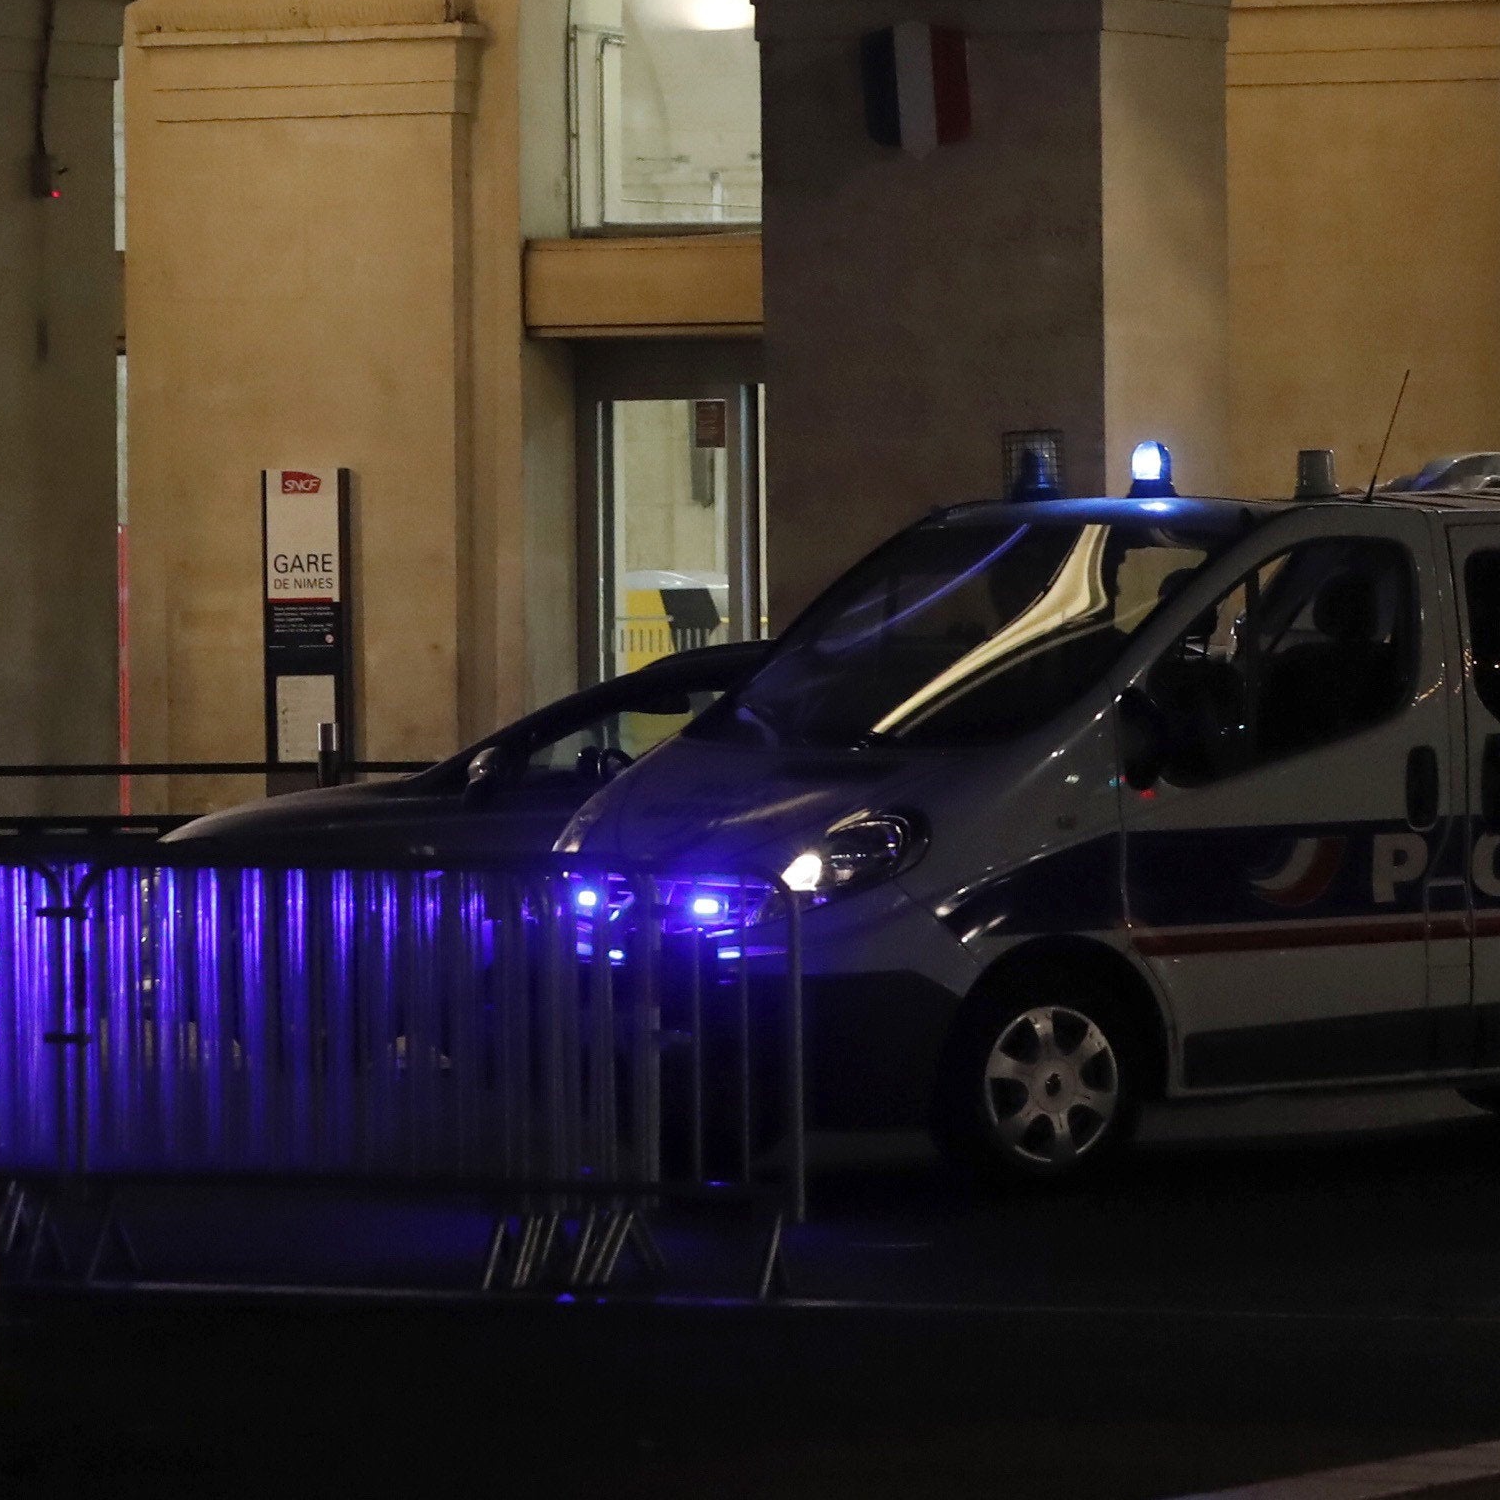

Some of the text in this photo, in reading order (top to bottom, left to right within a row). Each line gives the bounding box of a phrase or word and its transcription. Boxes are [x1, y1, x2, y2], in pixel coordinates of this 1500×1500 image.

[284, 479, 320, 492] SNCF
[273, 553, 333, 574] GARE
[274, 577, 334, 590] DE NIMES
